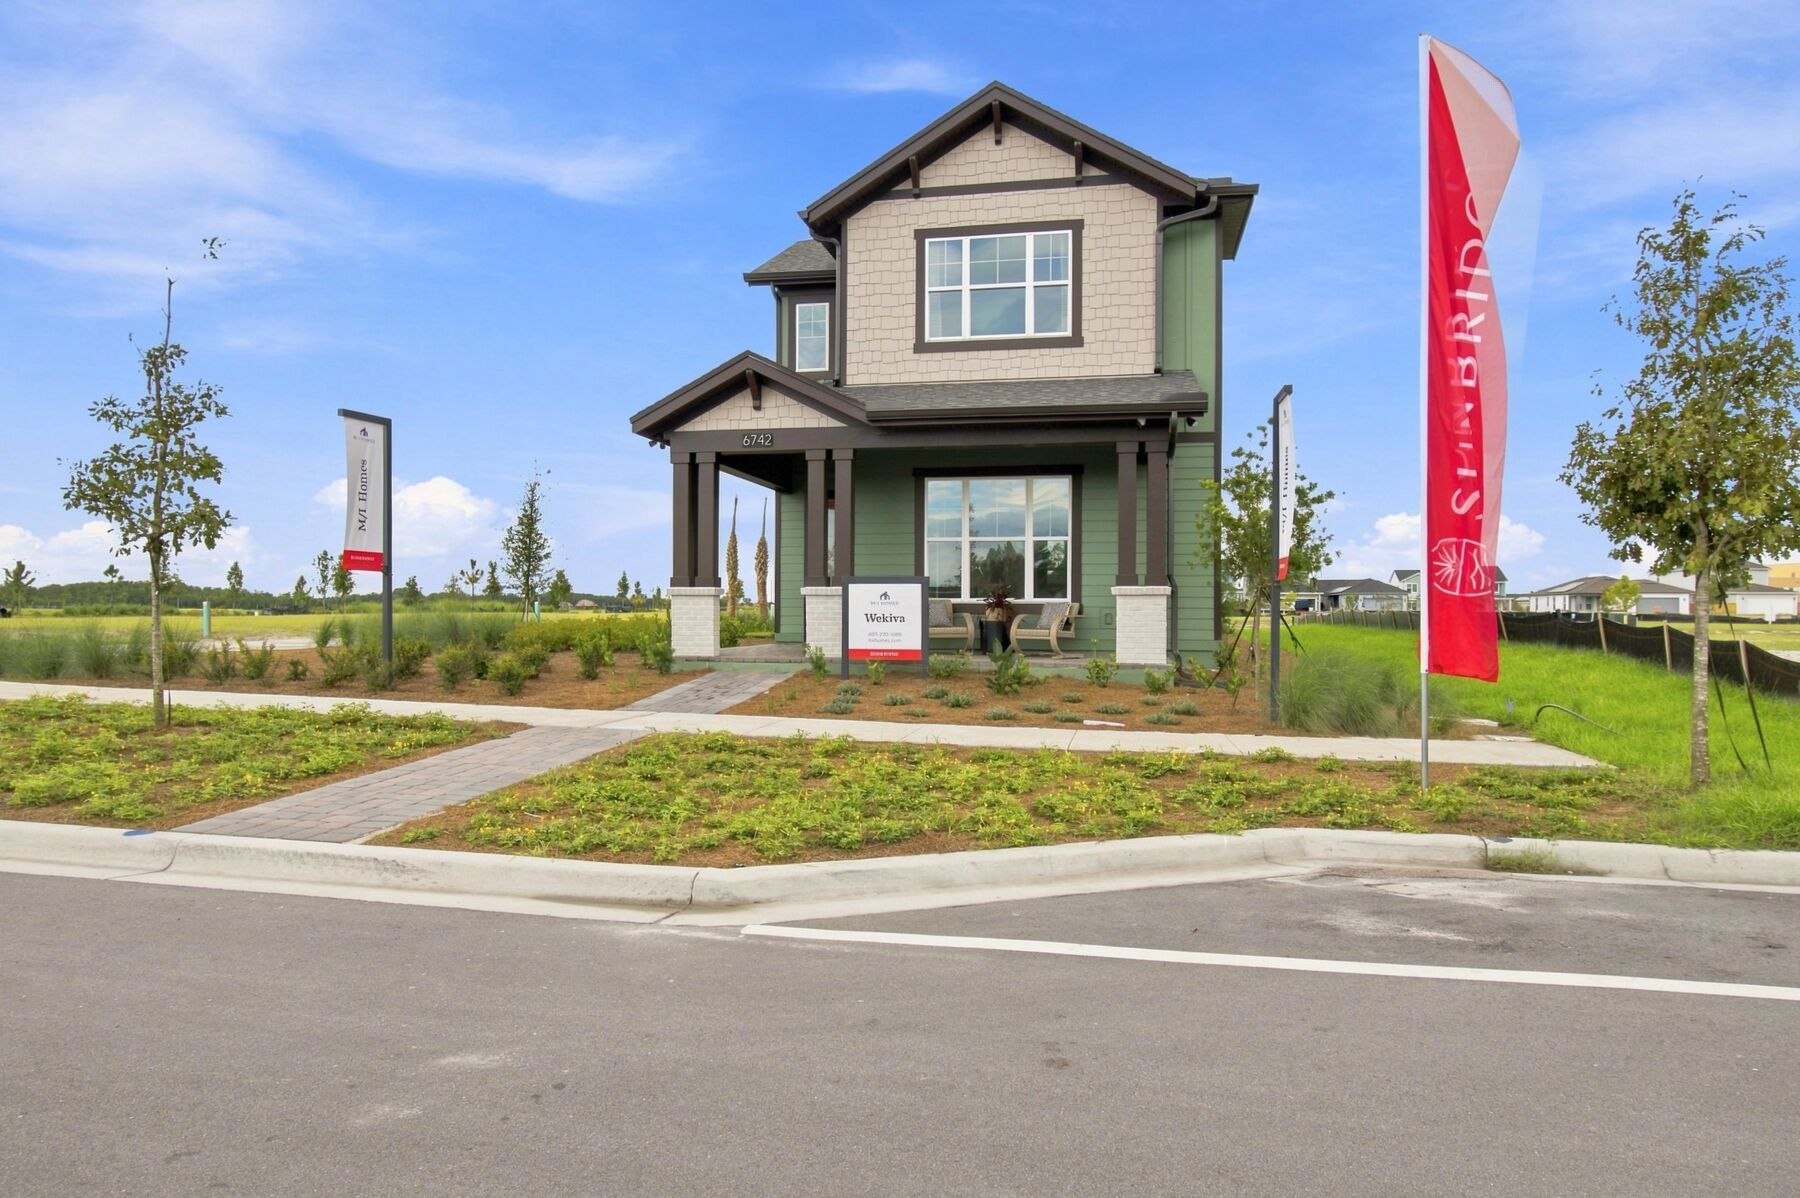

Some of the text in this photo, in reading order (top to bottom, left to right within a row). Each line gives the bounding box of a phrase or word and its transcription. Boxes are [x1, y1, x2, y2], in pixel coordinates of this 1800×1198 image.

[743, 433, 772, 446] 6742
[358, 458, 369, 531] M/I Homes
[864, 613, 906, 623] Wekiva
